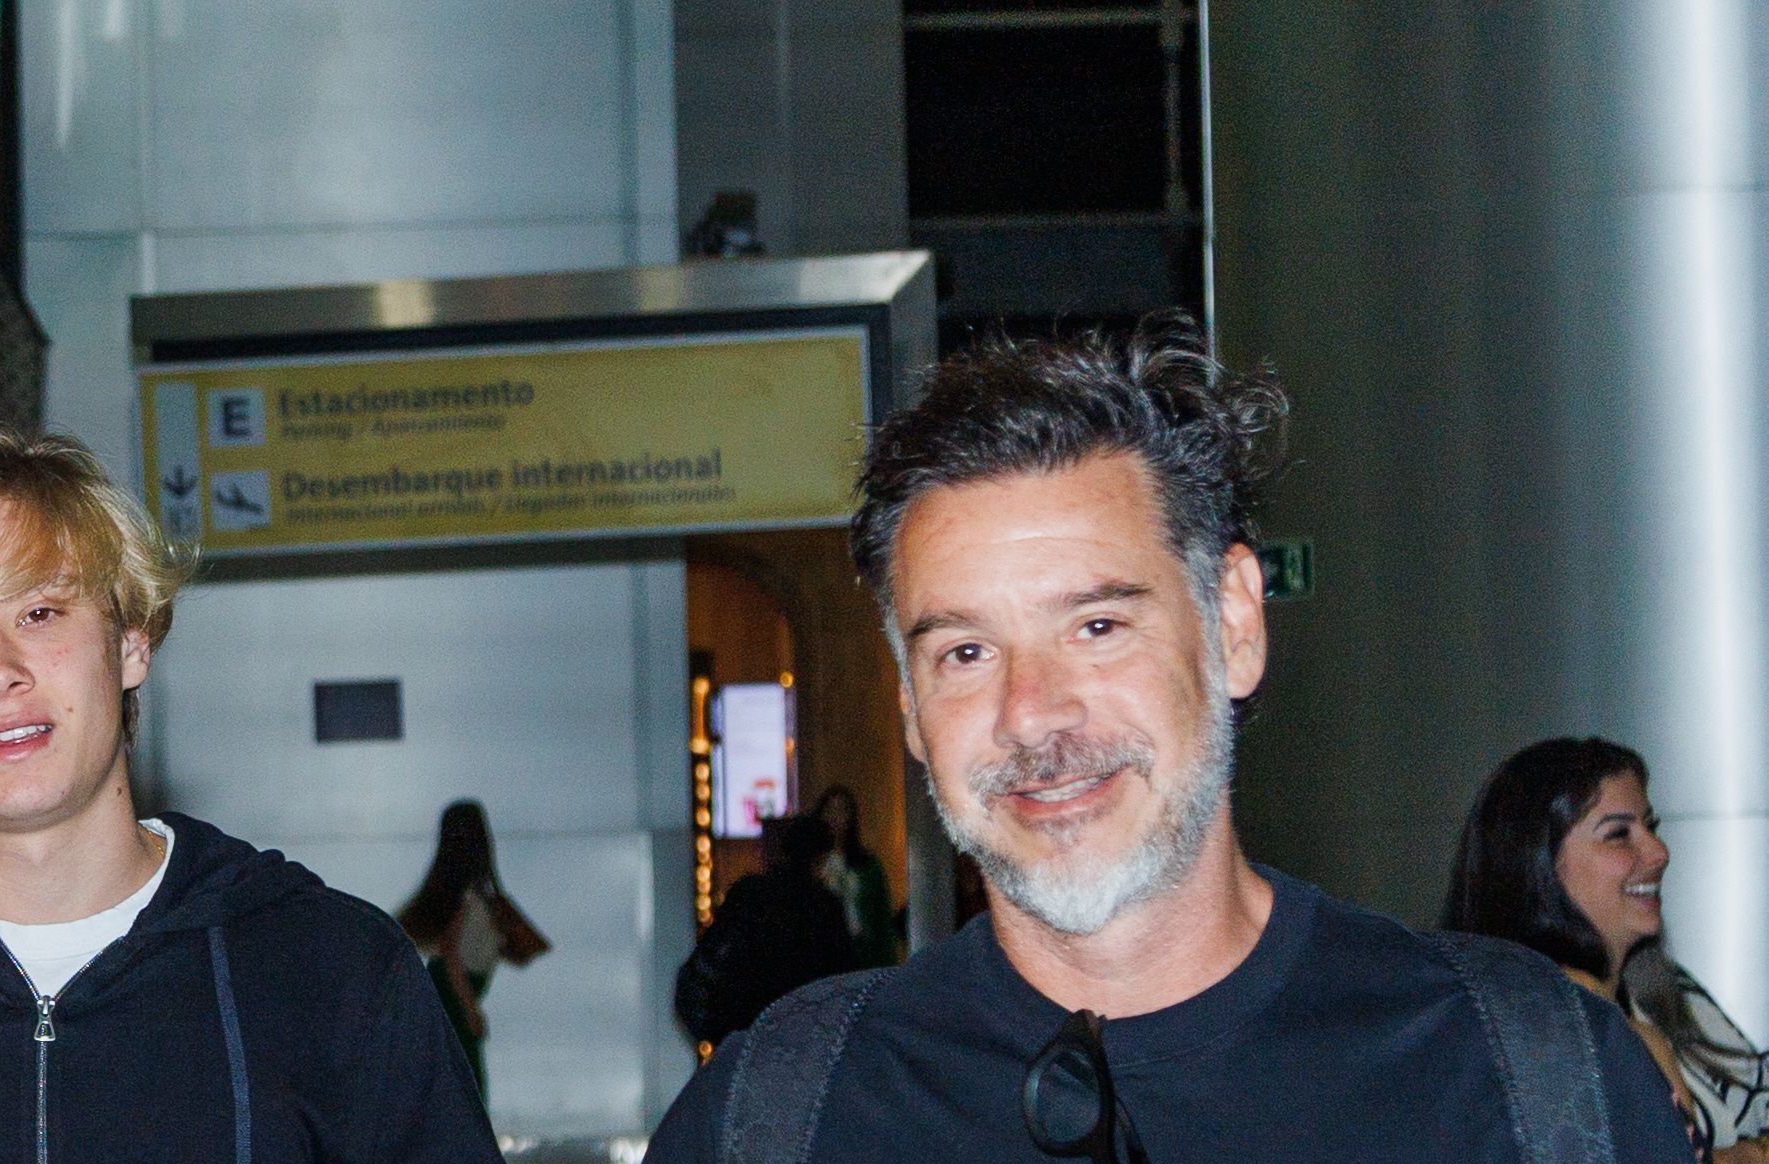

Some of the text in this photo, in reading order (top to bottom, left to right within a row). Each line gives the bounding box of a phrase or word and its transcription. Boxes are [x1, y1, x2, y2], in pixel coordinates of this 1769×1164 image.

[221, 395, 251, 438] E
[278, 380, 535, 419] Estacionamento
[283, 446, 722, 502] Desembarque internacional
